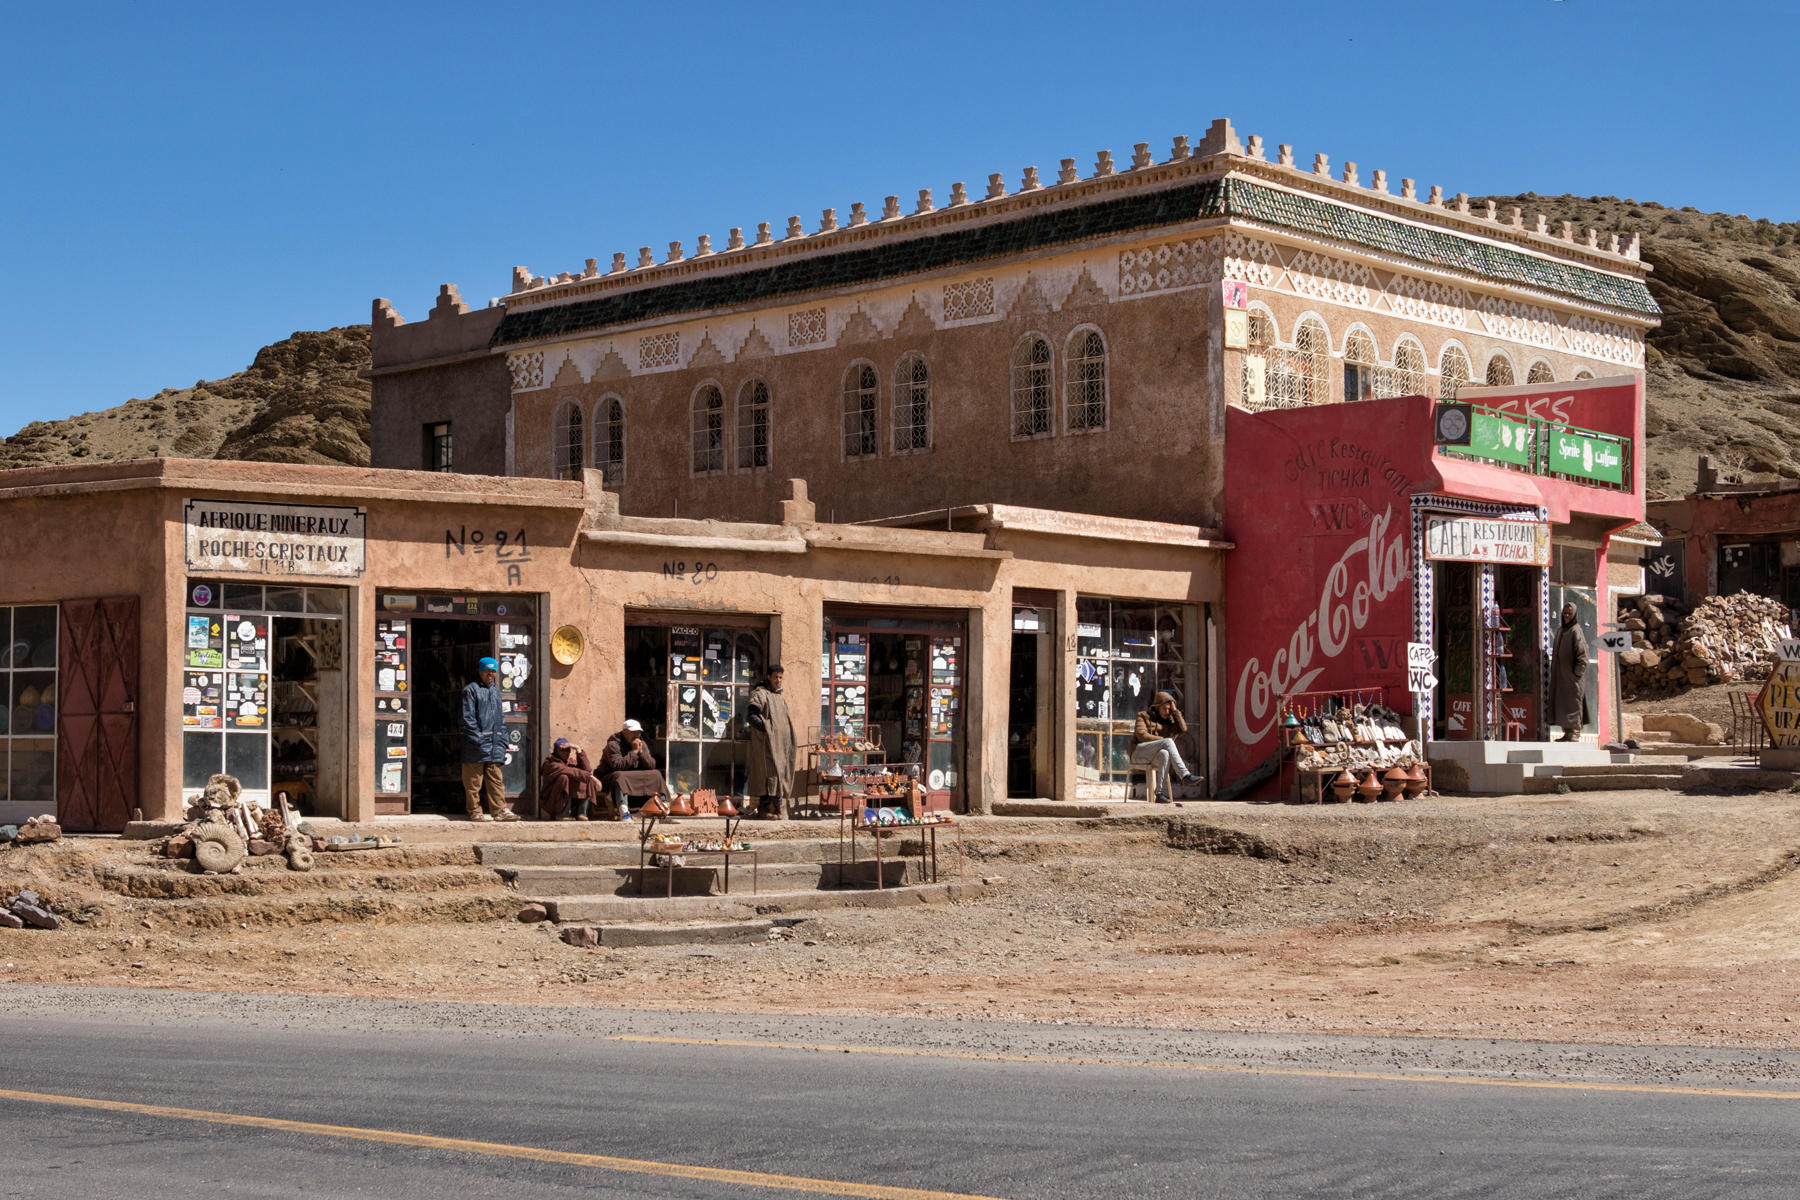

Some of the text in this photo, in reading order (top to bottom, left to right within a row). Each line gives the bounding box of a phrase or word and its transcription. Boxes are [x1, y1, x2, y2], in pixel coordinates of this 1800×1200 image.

[1559, 438, 1580, 460] Sprite
[1318, 467, 1371, 488] TICHKA
[200, 511, 349, 534] AFRIQUE MINERAUX
[495, 528, 531, 557] 21
[1429, 519, 1471, 556] CAFE
[200, 540, 348, 562] ROCHES CRISTAUX
[1494, 543, 1528, 558] TICHKA
[507, 564, 521, 586] A
[691, 561, 718, 585] 20
[1649, 555, 1675, 575] WC
[1234, 503, 1409, 745] Coca-Cola
[1066, 634, 1077, 651] 18
[1603, 637, 1625, 648] WC
[1409, 670, 1432, 691] WC
[1452, 700, 1472, 712] CAFE
[1511, 707, 1527, 719] WC
